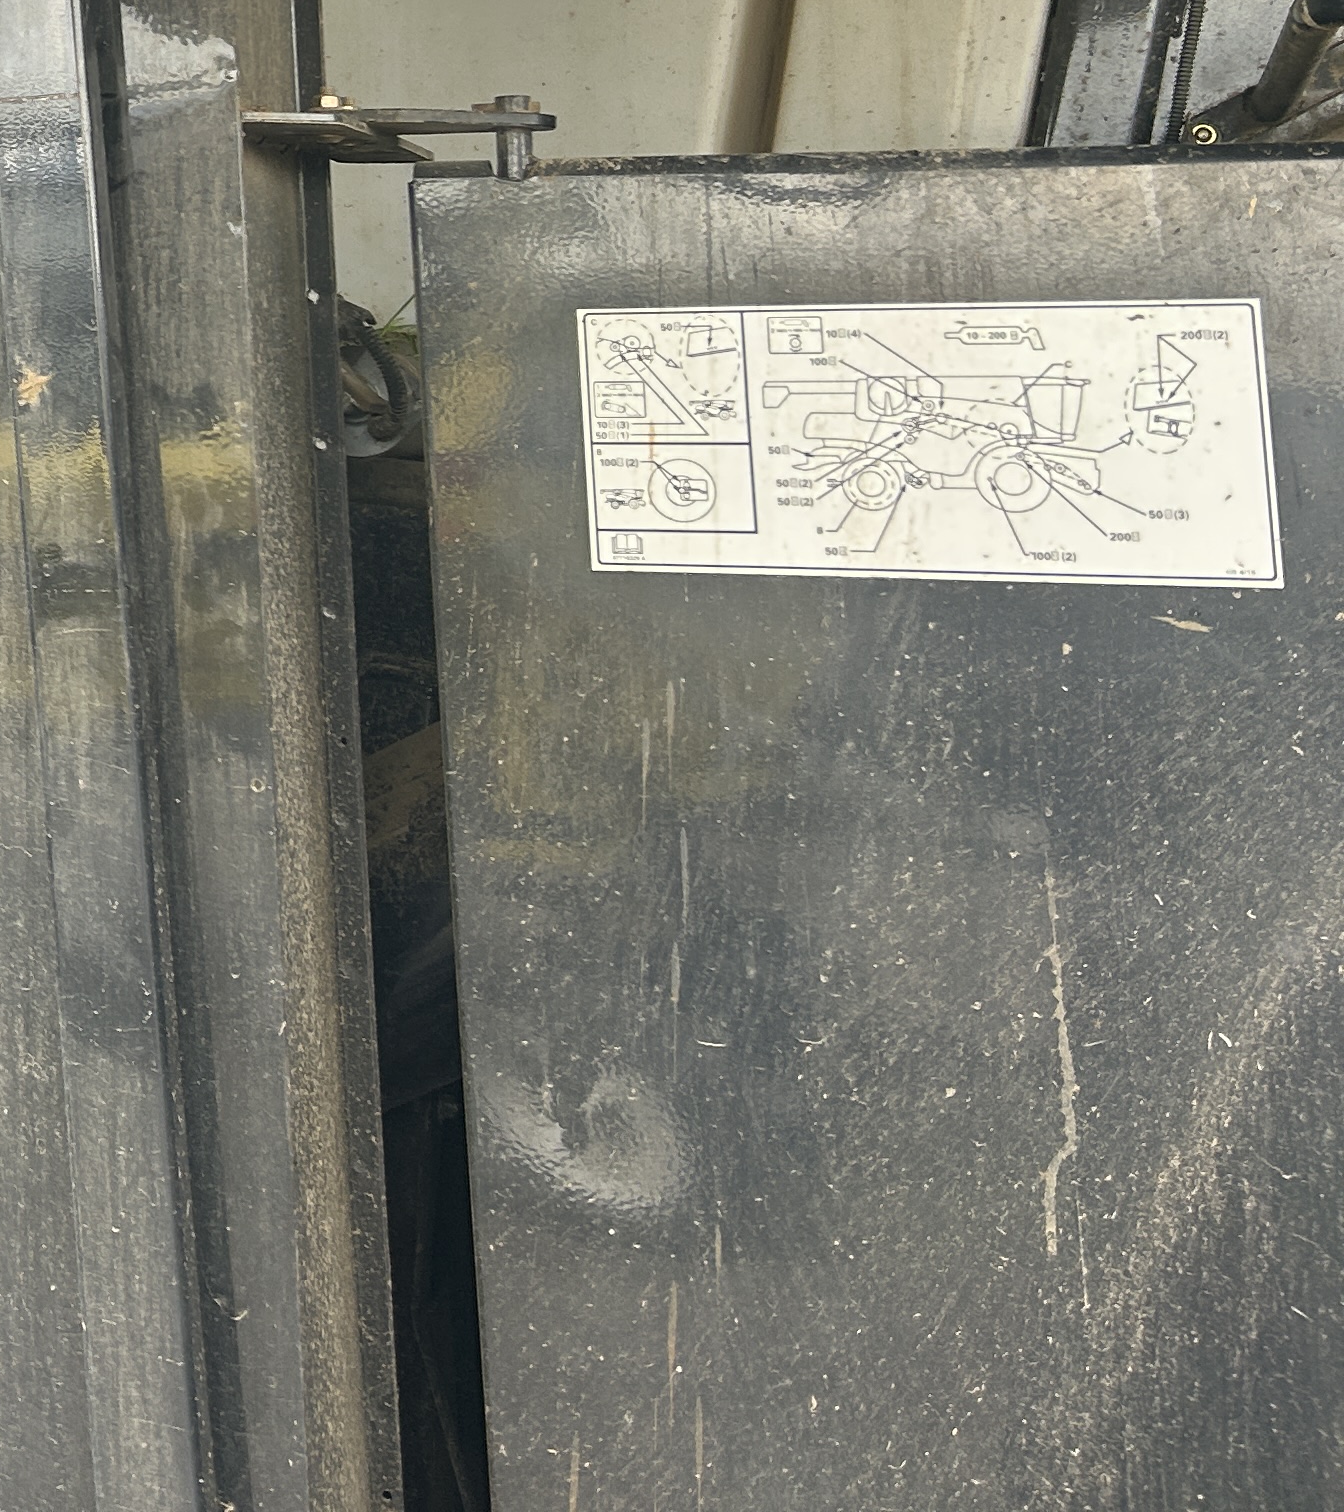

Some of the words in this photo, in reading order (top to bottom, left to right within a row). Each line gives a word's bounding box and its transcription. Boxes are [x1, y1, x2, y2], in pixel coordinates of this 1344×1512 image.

[826, 330, 837, 338] 10
[966, 331, 979, 340] 10
[988, 331, 1007, 340] 200
[1180, 331, 1202, 340] 200
[1213, 330, 1229, 341] (2)
[809, 357, 829, 366] 100
[596, 421, 608, 429] 10
[616, 420, 630, 430] (3)
[595, 431, 608, 440] 50
[616, 431, 630, 441] (1)
[768, 446, 781, 455] 50
[600, 458, 618, 467] 100
[625, 458, 639, 468] (2)
[776, 479, 789, 488] 50
[798, 478, 813, 489] (2)
[777, 497, 791, 506] 50
[799, 497, 814, 507] (2)
[1148, 510, 1163, 519] 50
[1174, 510, 1190, 521] (3)
[1109, 532, 1132, 542] 200
[825, 547, 838, 556] 50
[1062, 552, 1077, 563] (2)
